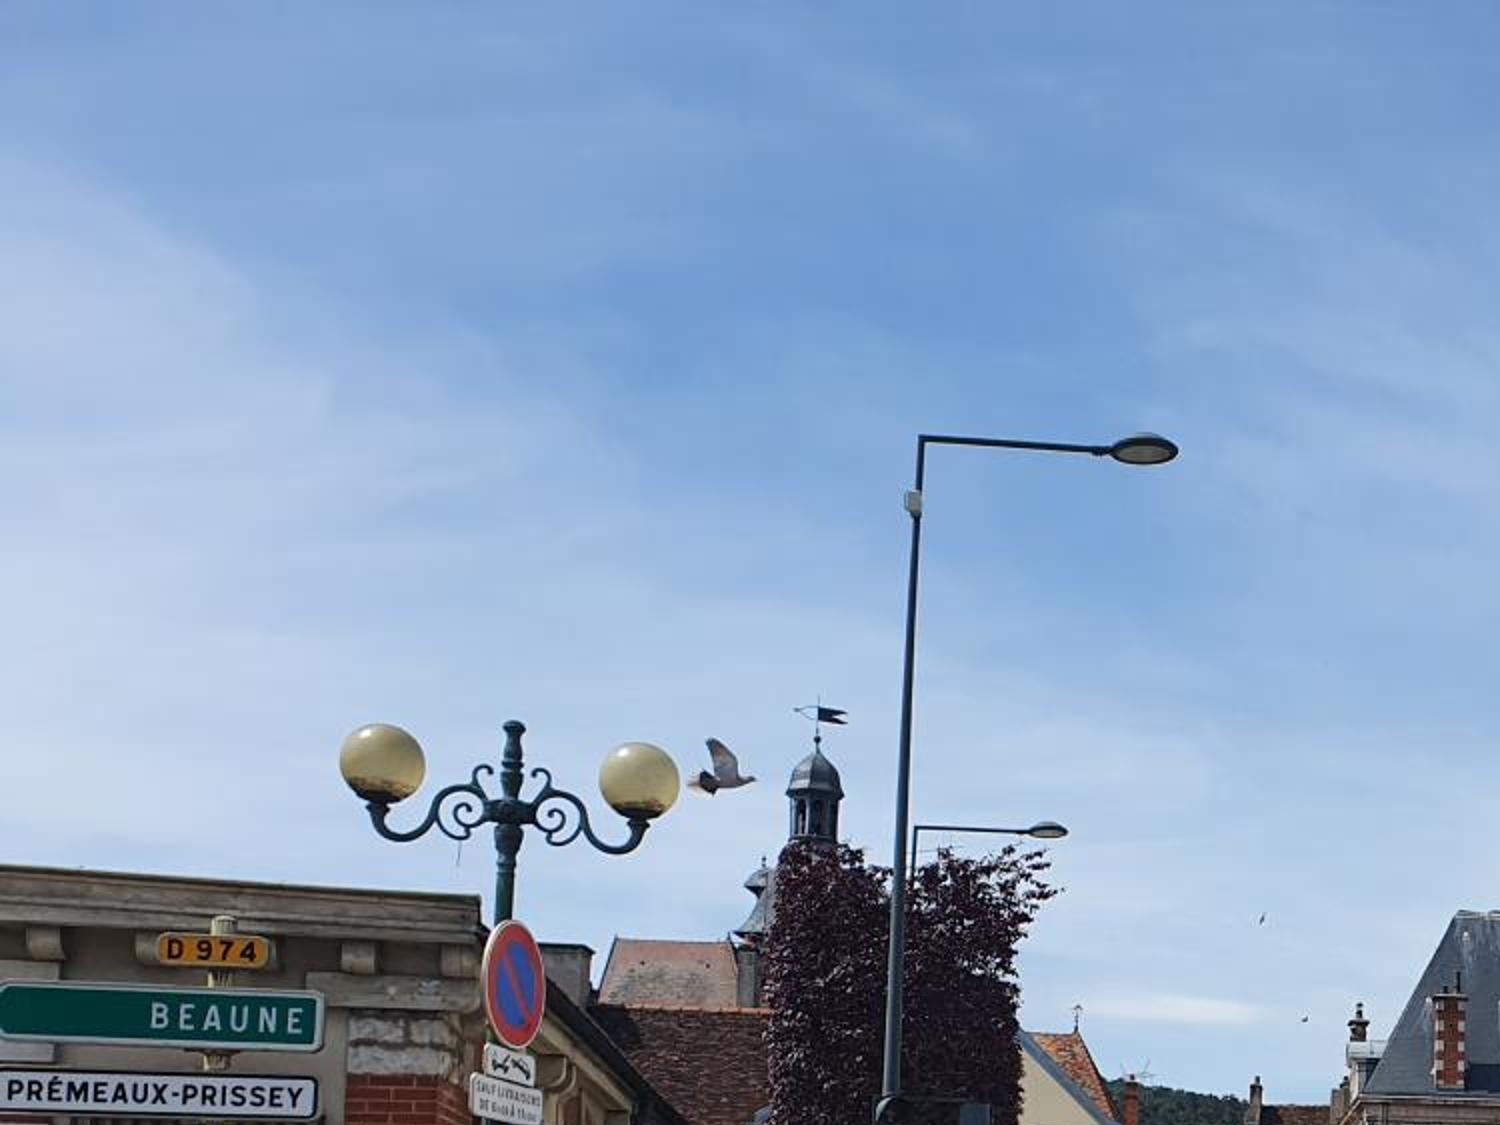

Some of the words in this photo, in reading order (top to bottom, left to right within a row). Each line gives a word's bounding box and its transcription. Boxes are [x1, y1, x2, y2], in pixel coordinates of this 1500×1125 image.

[166, 938, 185, 960] D
[196, 939, 257, 962] 974
[150, 1002, 304, 1035] BEAUNE
[6, 1076, 304, 1110] PRÉMEAUX-PRISSEY
